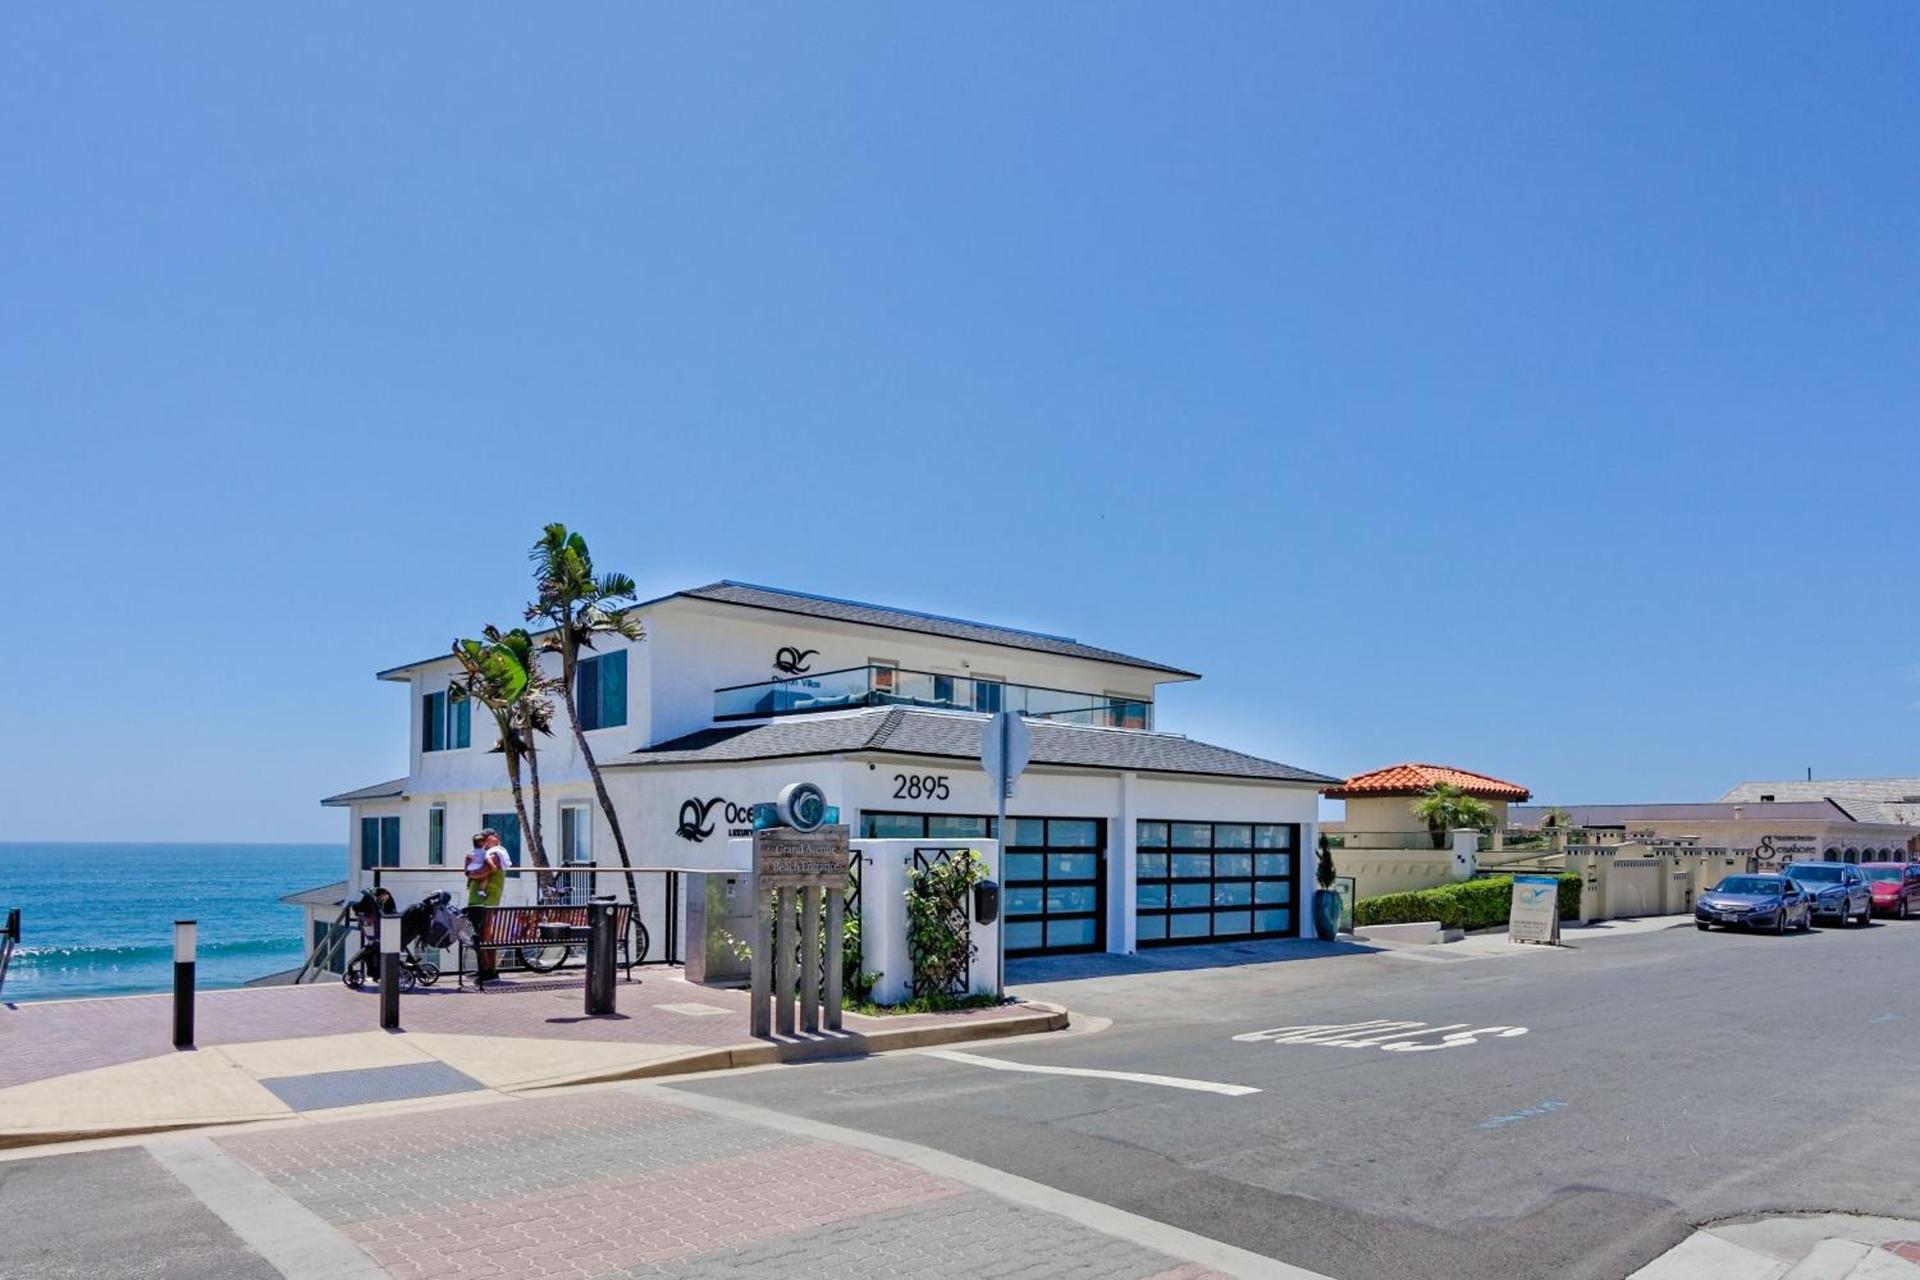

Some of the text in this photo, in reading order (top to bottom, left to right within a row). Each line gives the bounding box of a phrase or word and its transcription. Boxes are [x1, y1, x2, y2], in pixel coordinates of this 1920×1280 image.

[893, 774, 950, 800] 2895
[725, 801, 754, 824] Oce
[775, 843, 837, 855] Grand Avenue
[773, 861, 840, 873] Beach Entrance
